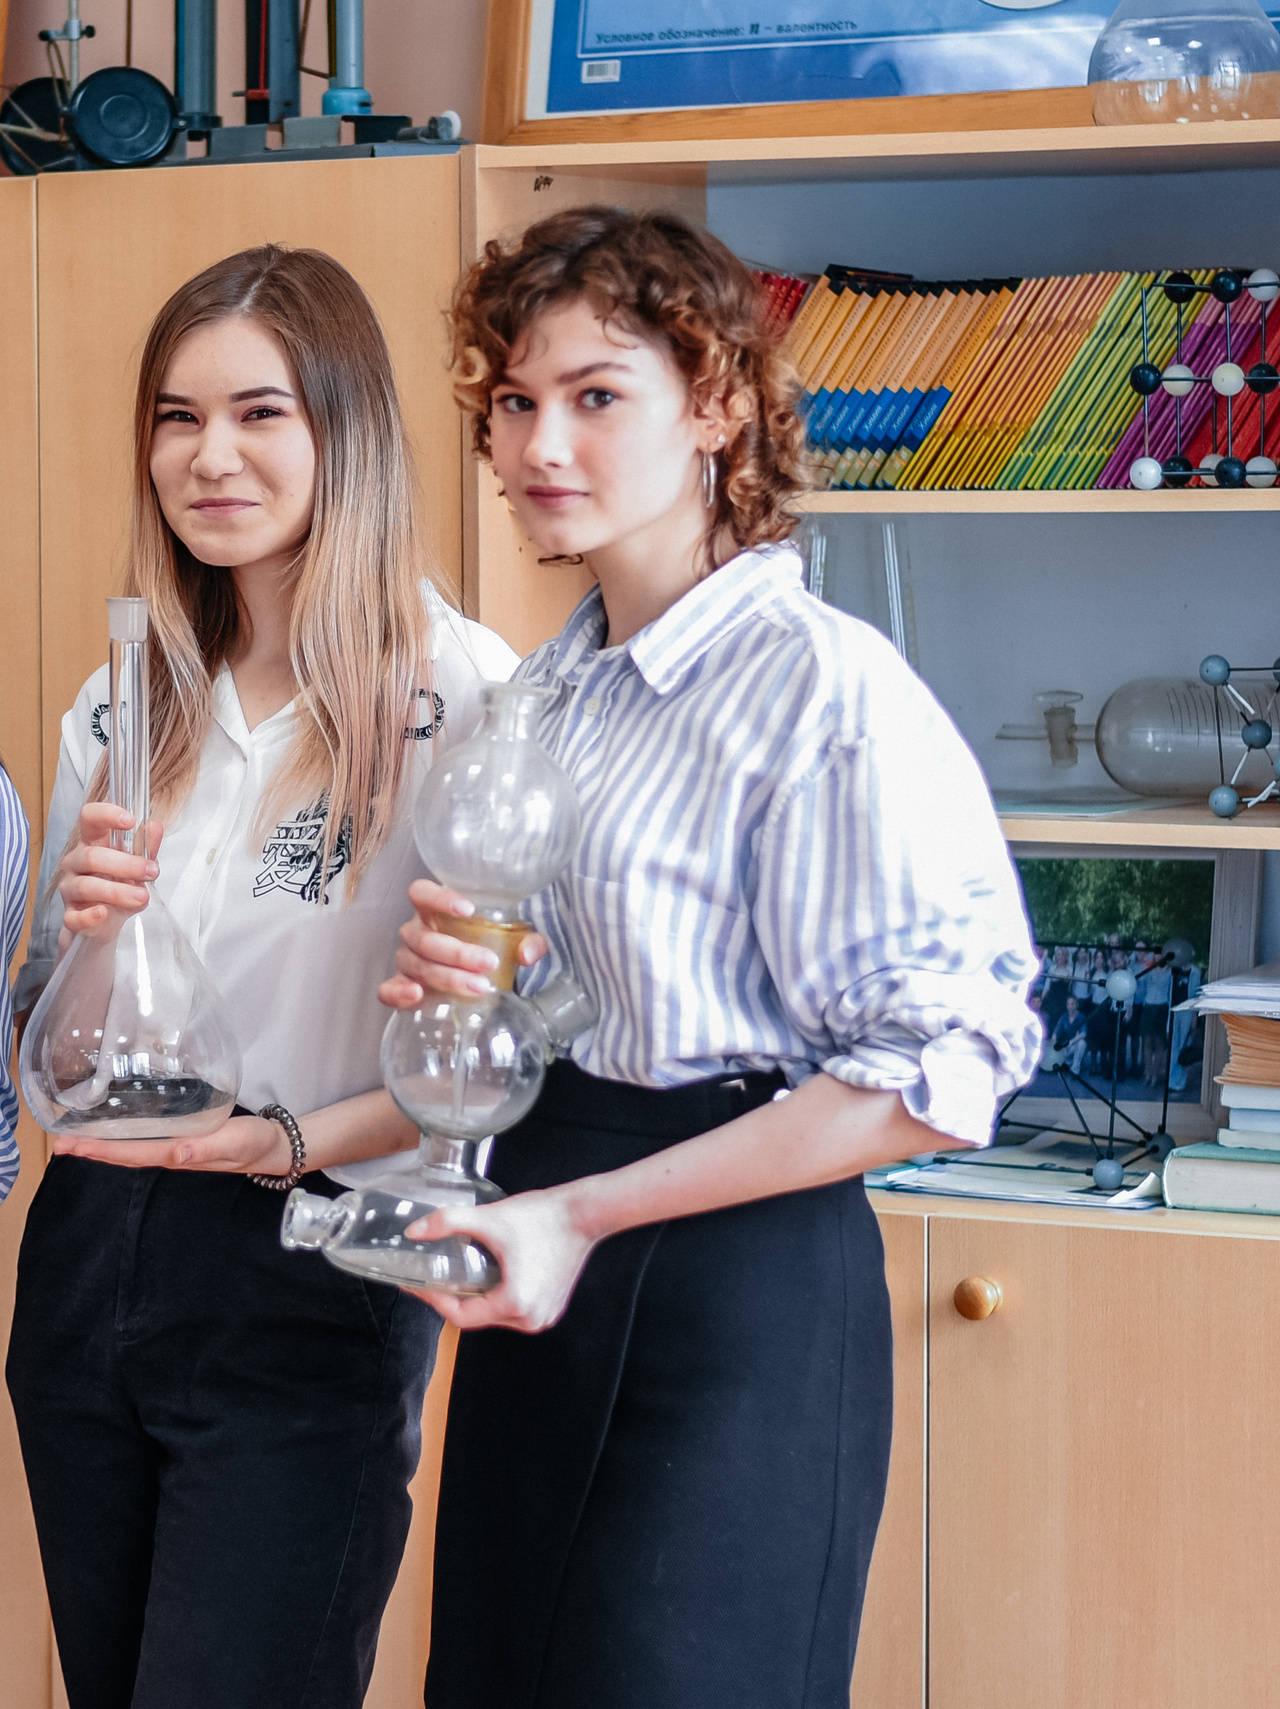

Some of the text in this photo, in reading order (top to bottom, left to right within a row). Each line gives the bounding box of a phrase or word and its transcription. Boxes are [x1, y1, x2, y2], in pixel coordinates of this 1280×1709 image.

[596, 32, 654, 43] Условное
[658, 27, 744, 40] обозначение:
[776, 20, 858, 34] валентность
[919, 403, 938, 432] Химия
